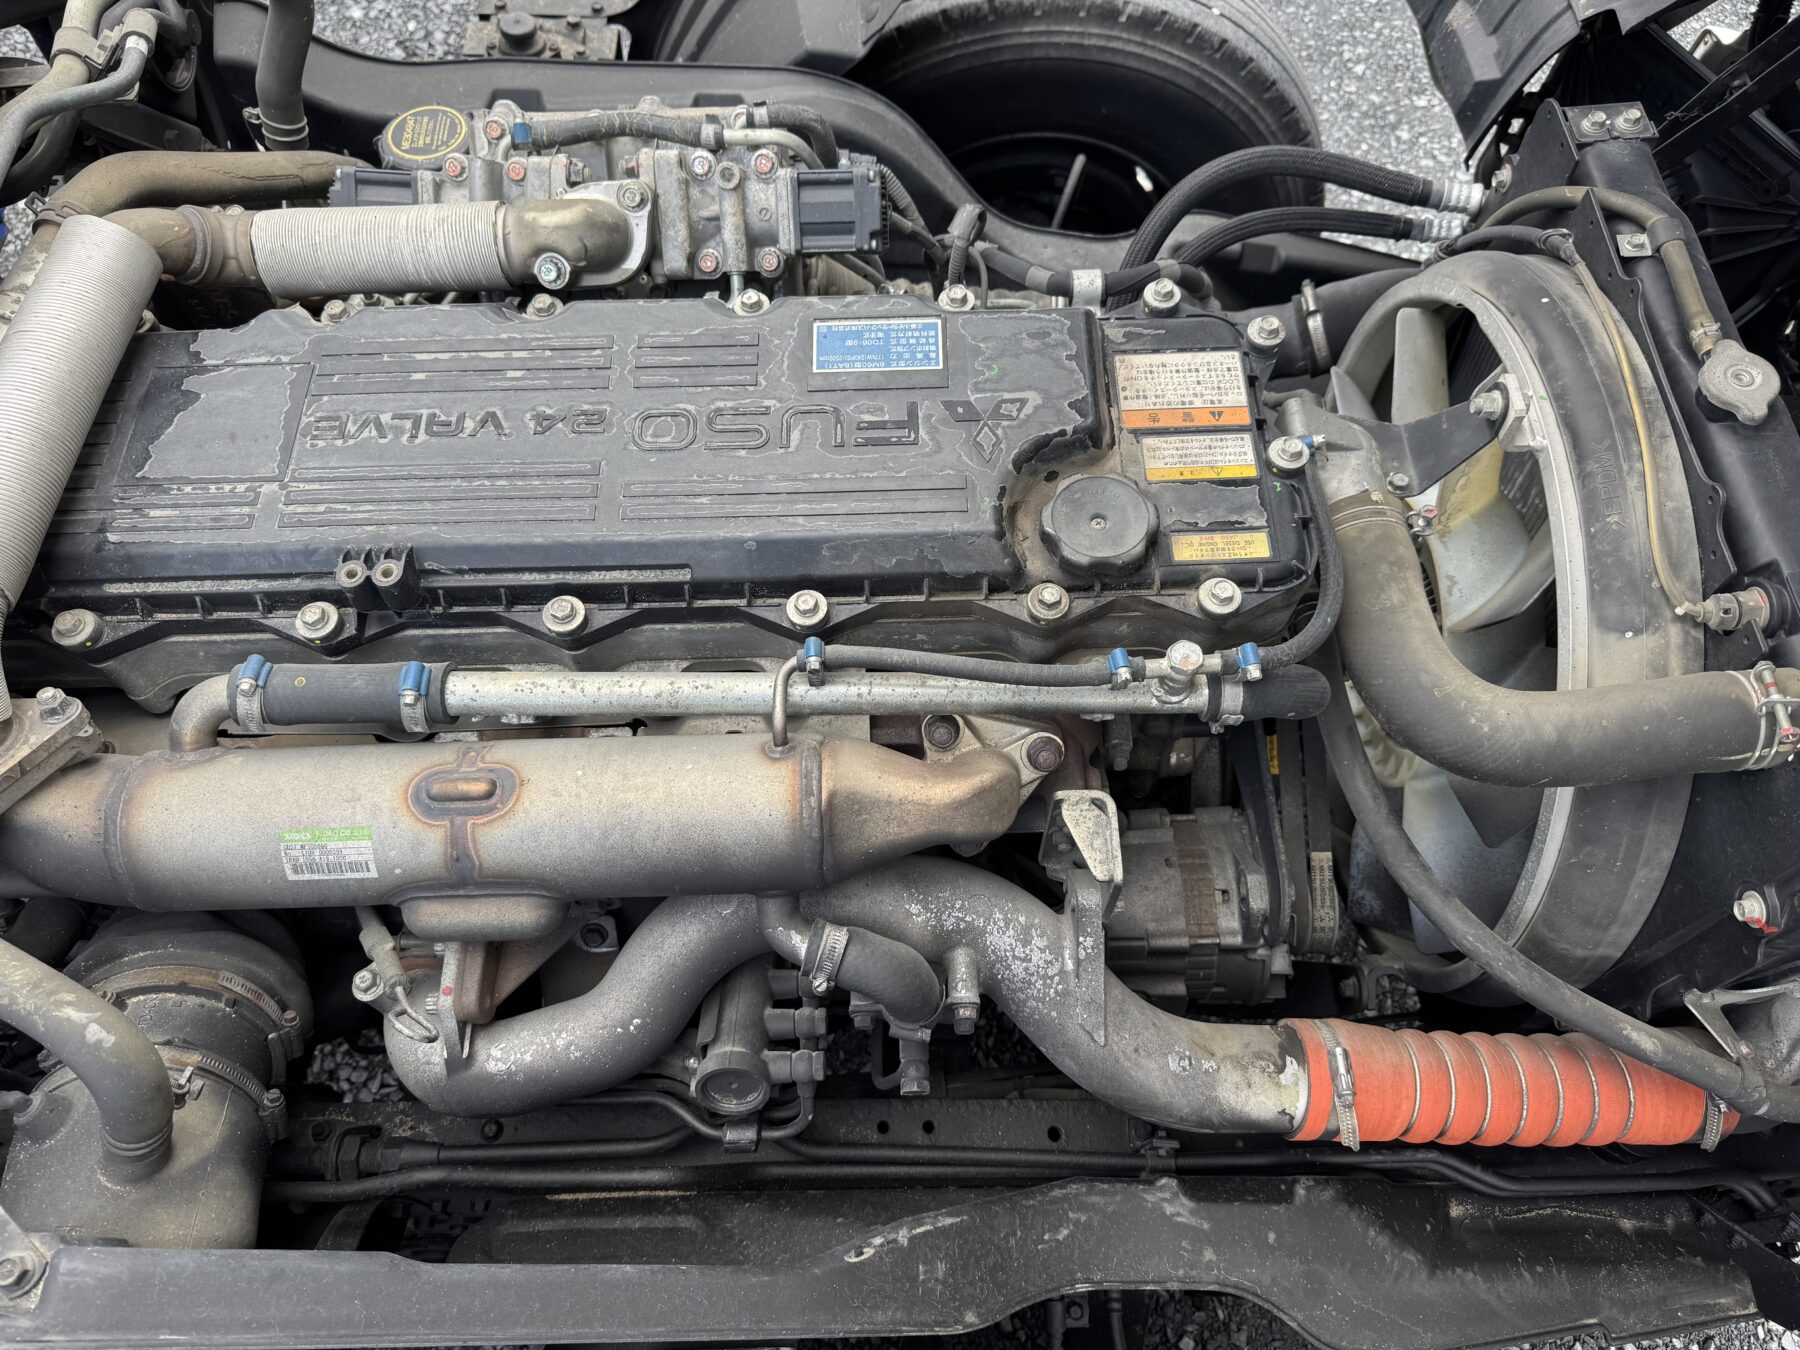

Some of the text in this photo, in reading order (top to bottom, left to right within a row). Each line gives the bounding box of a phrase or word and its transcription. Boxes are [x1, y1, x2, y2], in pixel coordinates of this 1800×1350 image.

[302, 401, 919, 451] FUSO 24 VALVE
